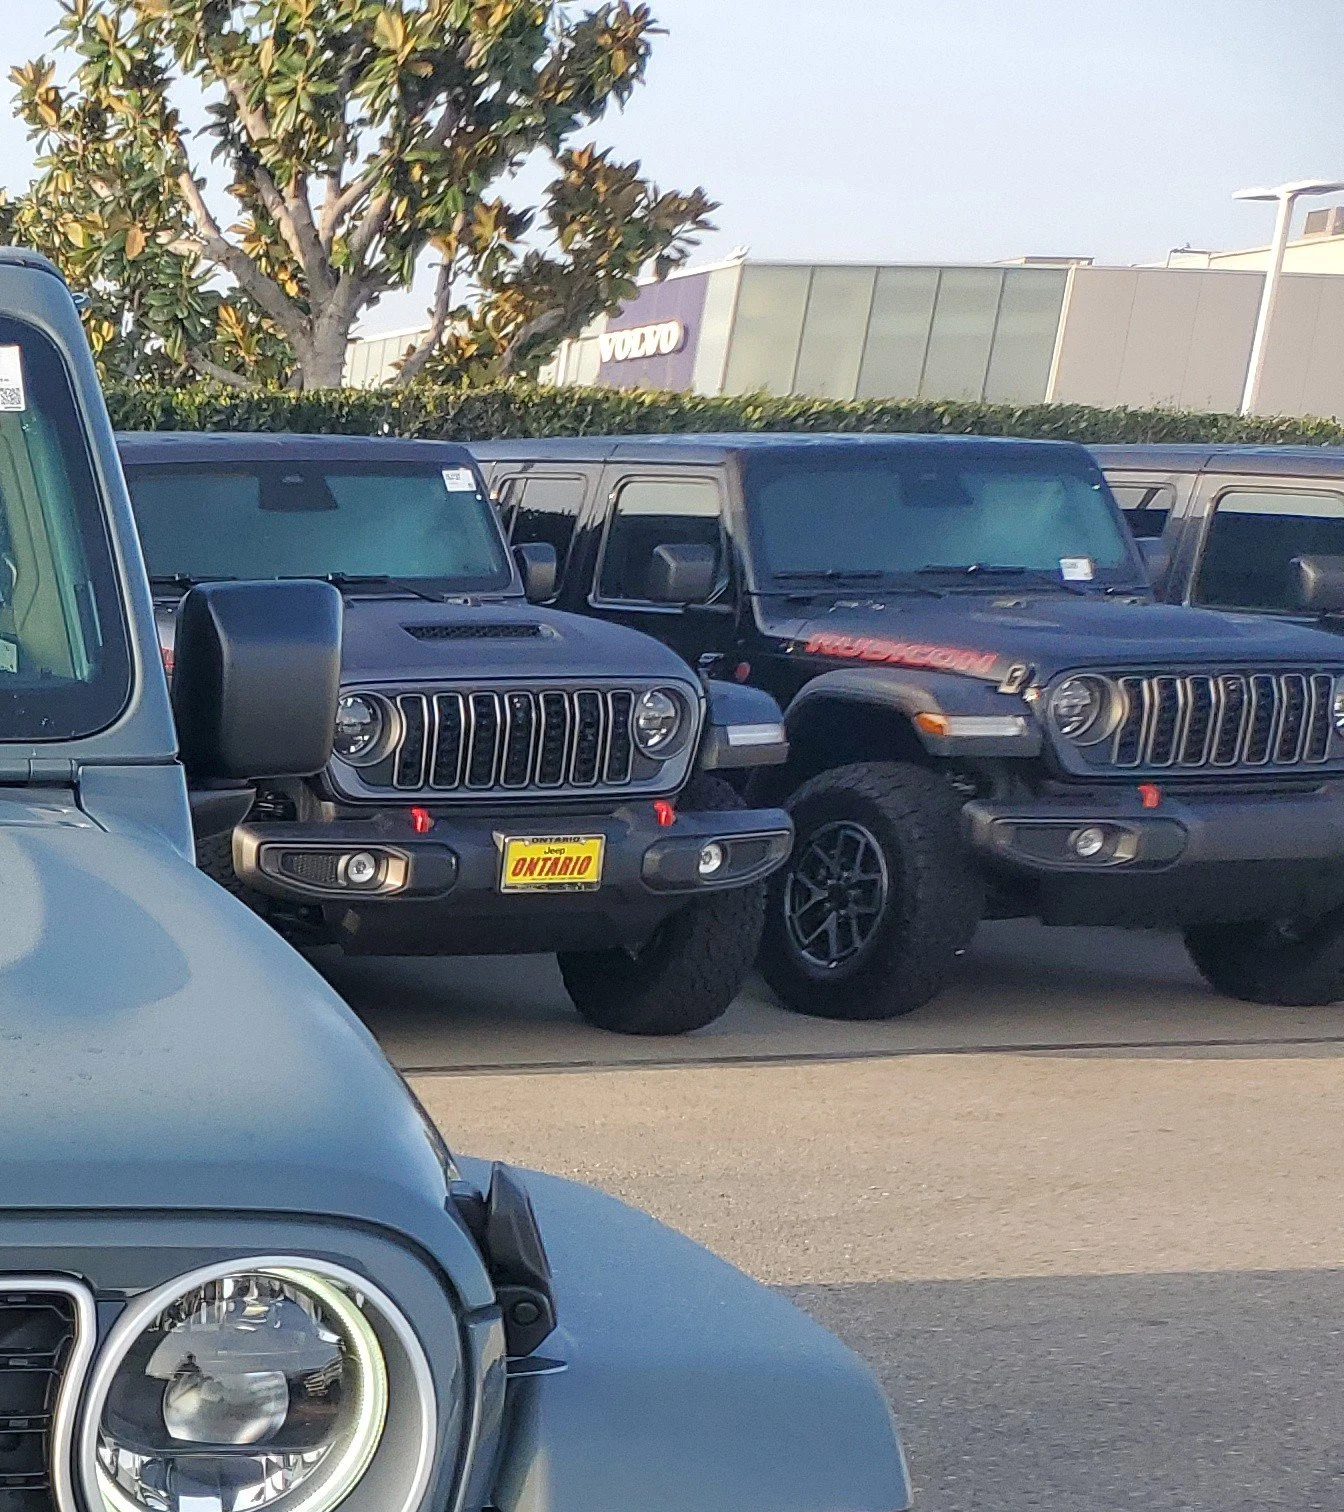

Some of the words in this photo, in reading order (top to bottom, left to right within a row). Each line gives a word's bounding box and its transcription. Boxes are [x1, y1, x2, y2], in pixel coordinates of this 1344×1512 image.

[599, 321, 681, 363] VOLVO
[544, 847, 565, 855] Jeep
[512, 856, 593, 877] ONTARIO
